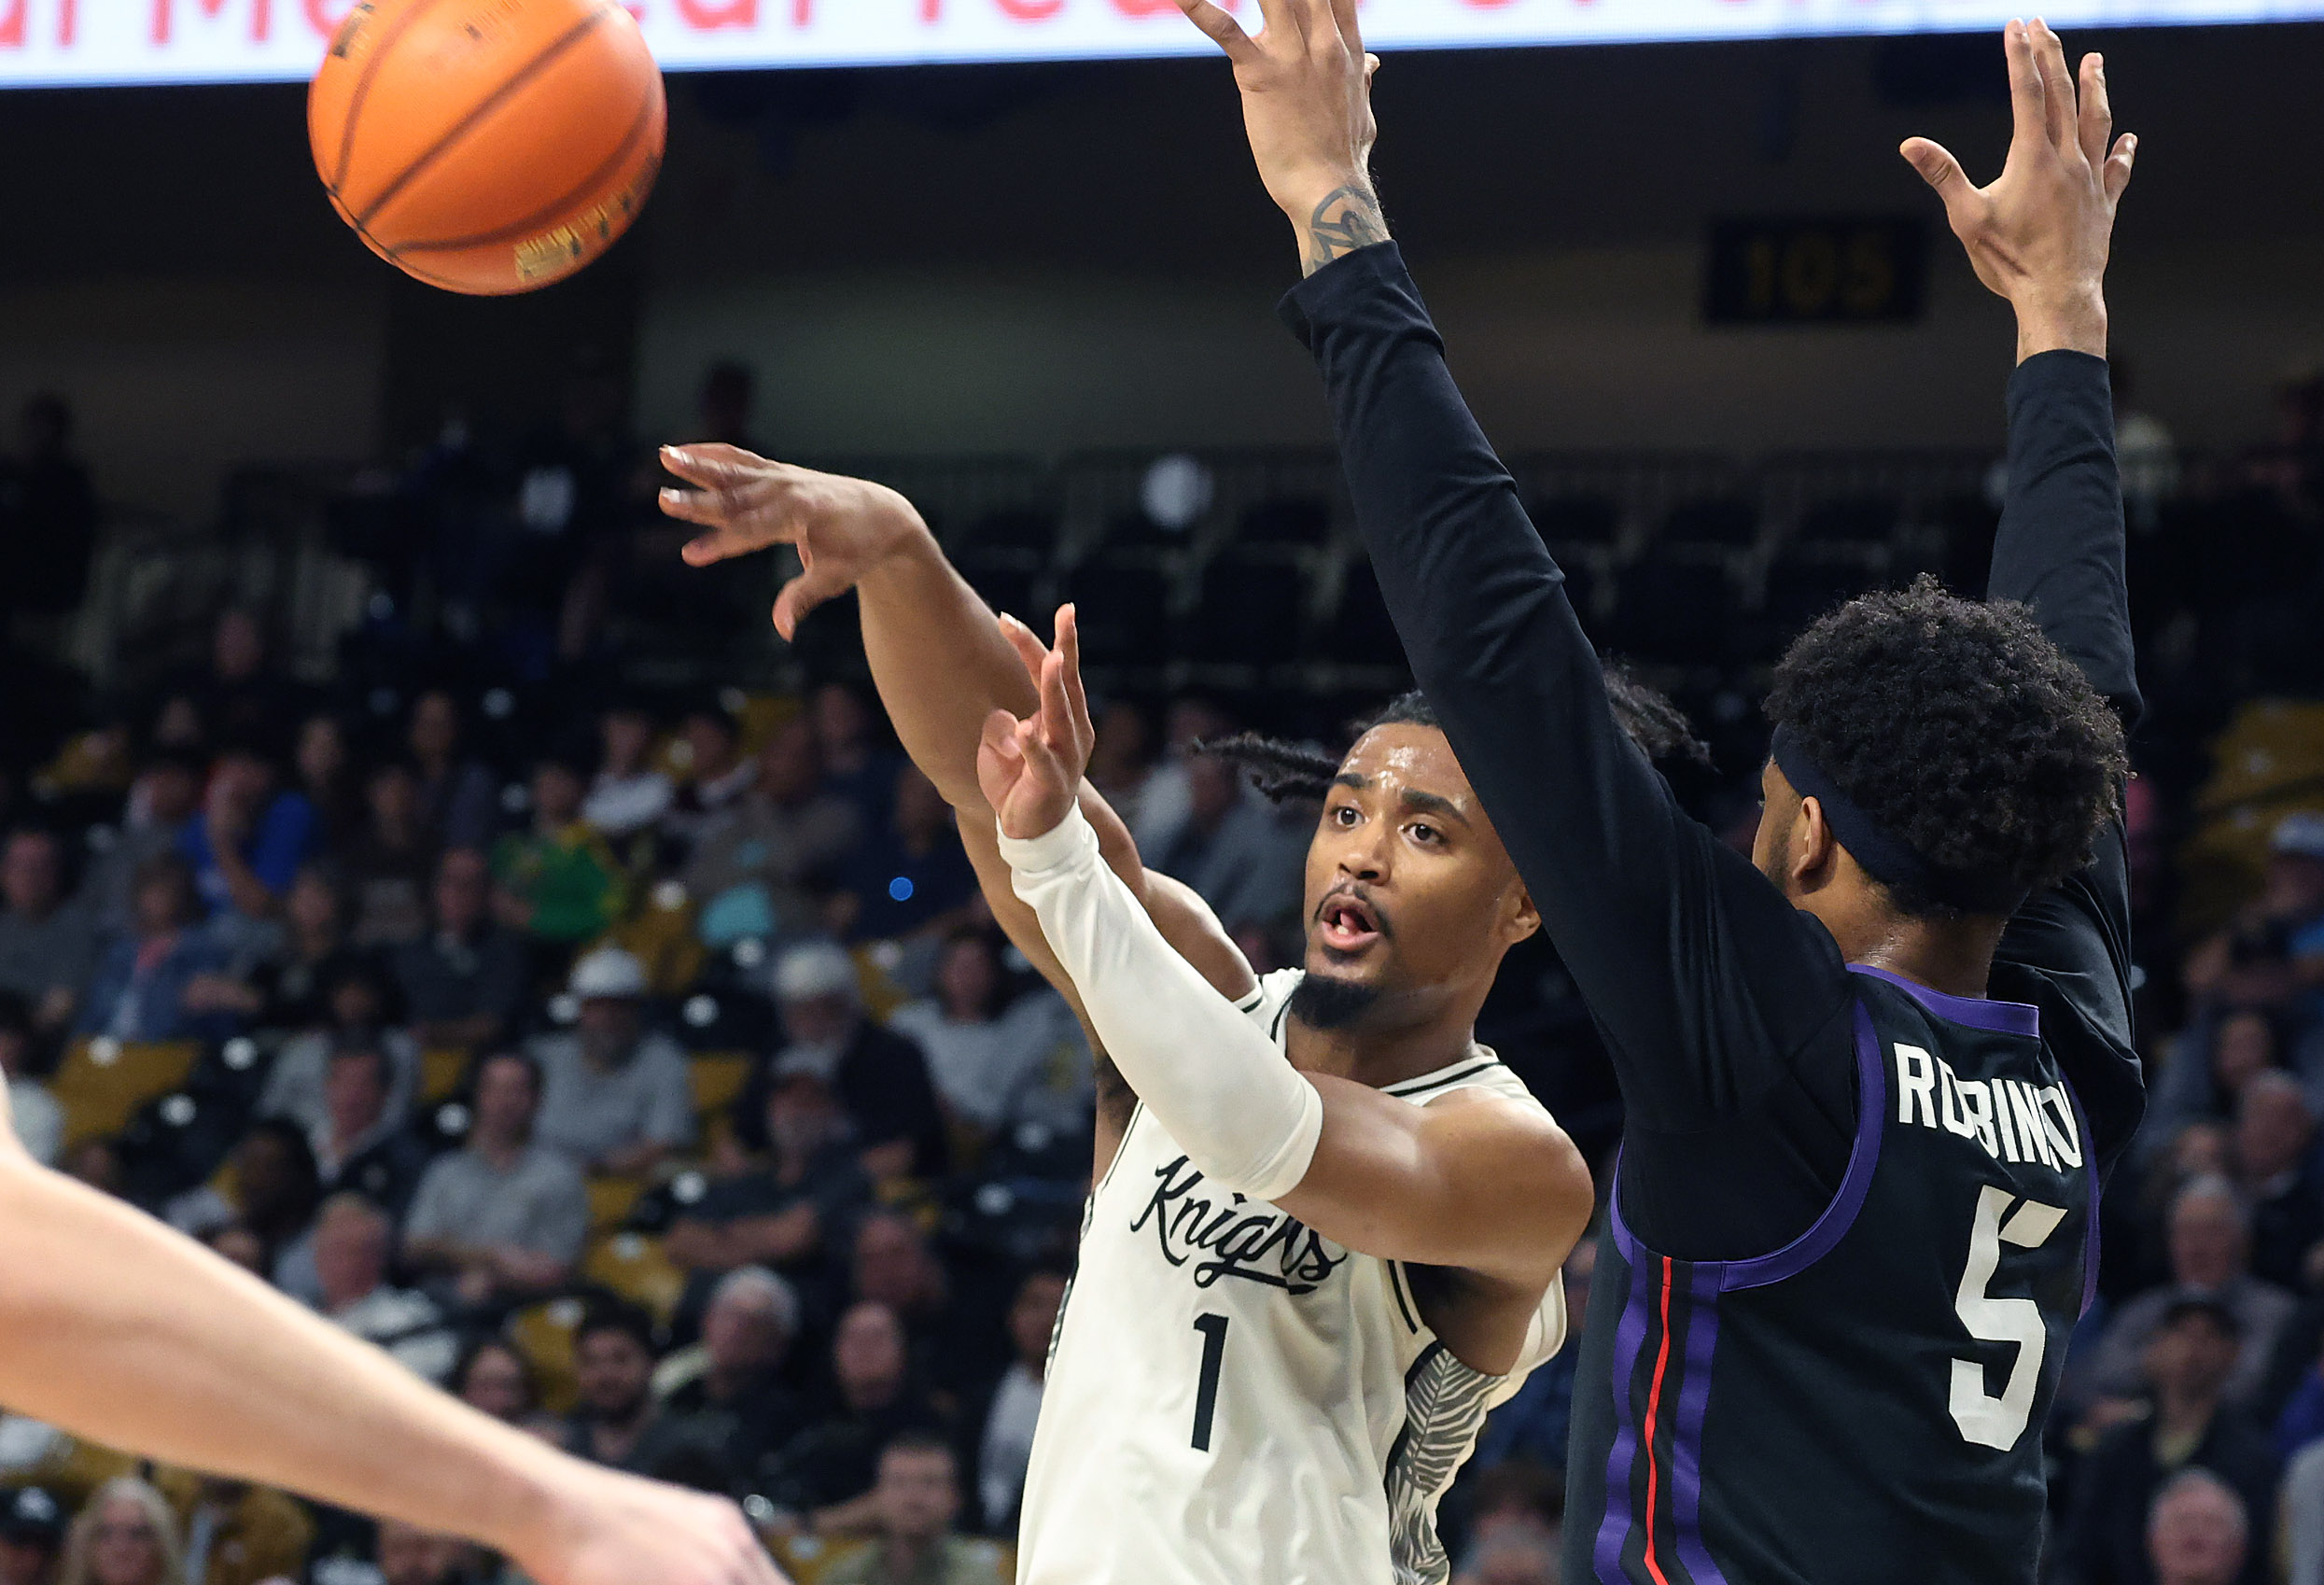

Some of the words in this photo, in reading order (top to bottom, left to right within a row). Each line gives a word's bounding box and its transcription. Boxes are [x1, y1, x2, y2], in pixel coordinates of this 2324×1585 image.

[1745, 233, 1892, 312] 105
[1191, 1312, 1229, 1452] 1
[1949, 1185, 2068, 1452] 5
